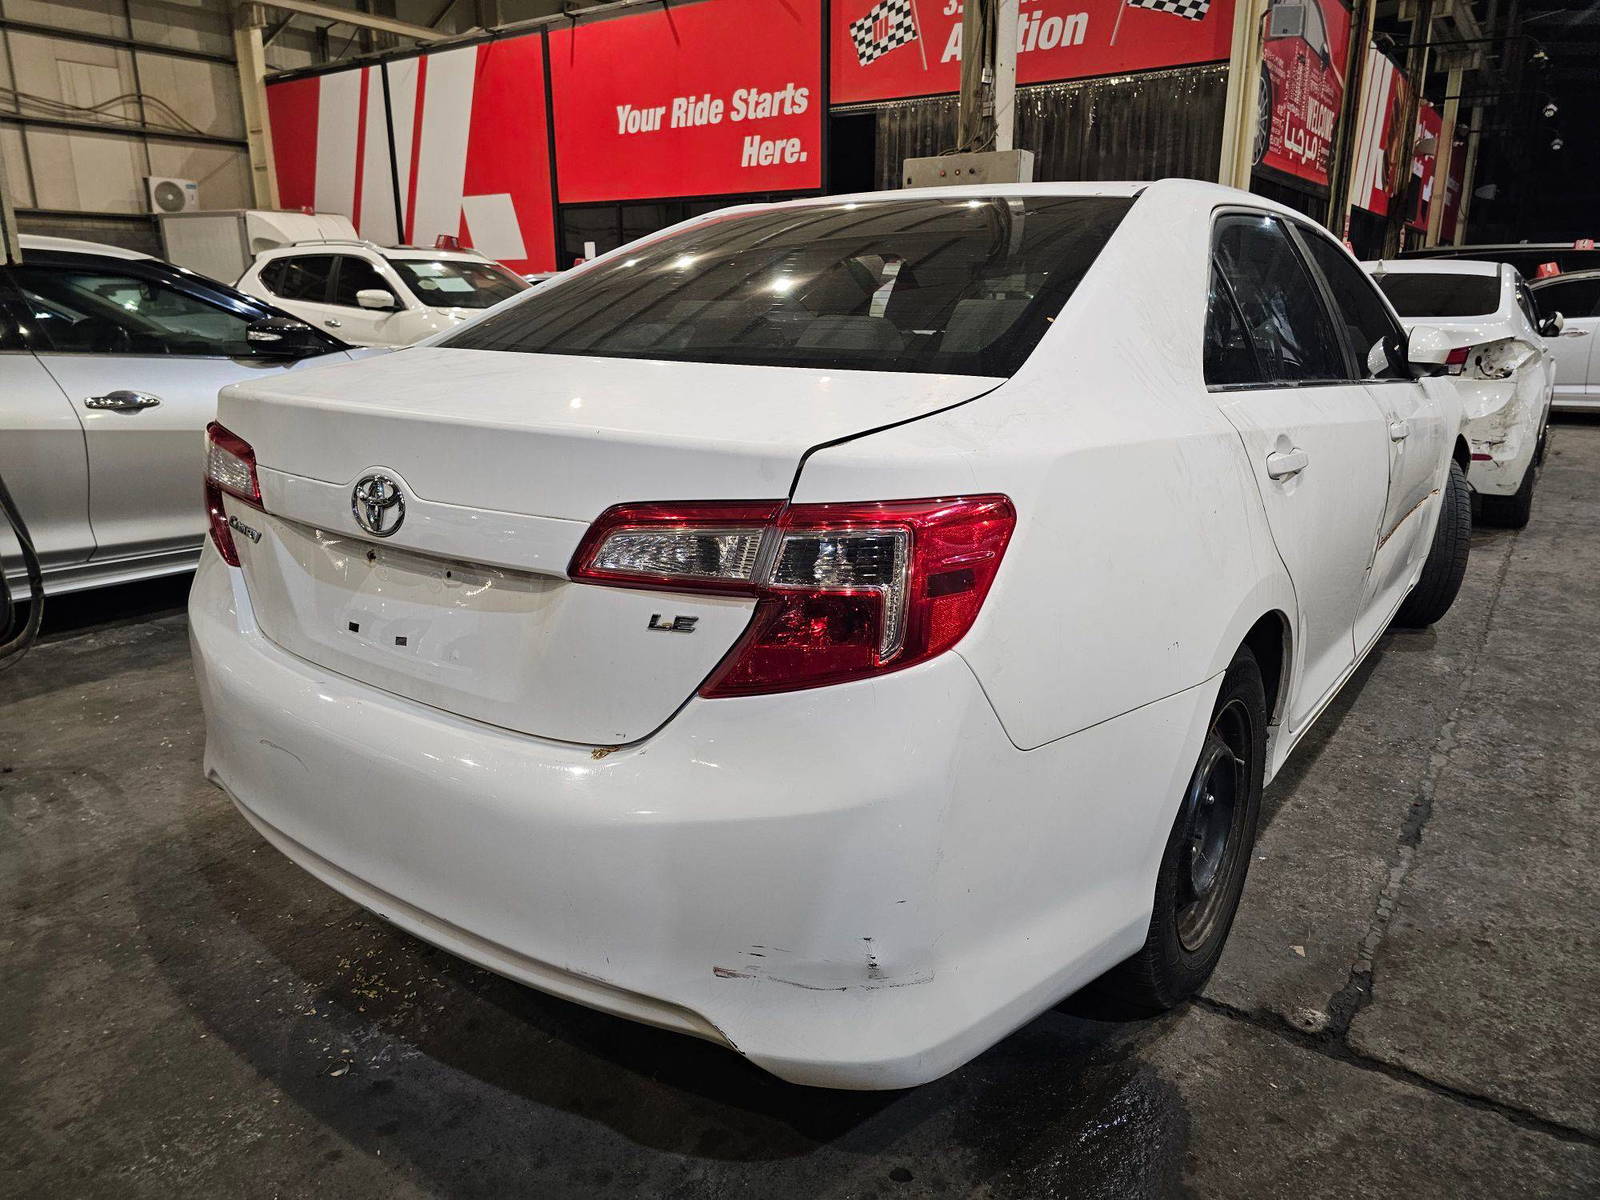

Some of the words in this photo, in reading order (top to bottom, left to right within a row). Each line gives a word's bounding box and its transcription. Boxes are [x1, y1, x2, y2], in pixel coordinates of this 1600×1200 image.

[940, 10, 1089, 64] Ation
[616, 104, 667, 135] Your
[670, 93, 725, 128] Ride
[730, 82, 810, 122] Starts
[1305, 95, 1335, 142] WELCOME
[741, 135, 808, 168] Here.
[1284, 111, 1318, 165] مرحبا
[648, 613, 699, 633] LE
